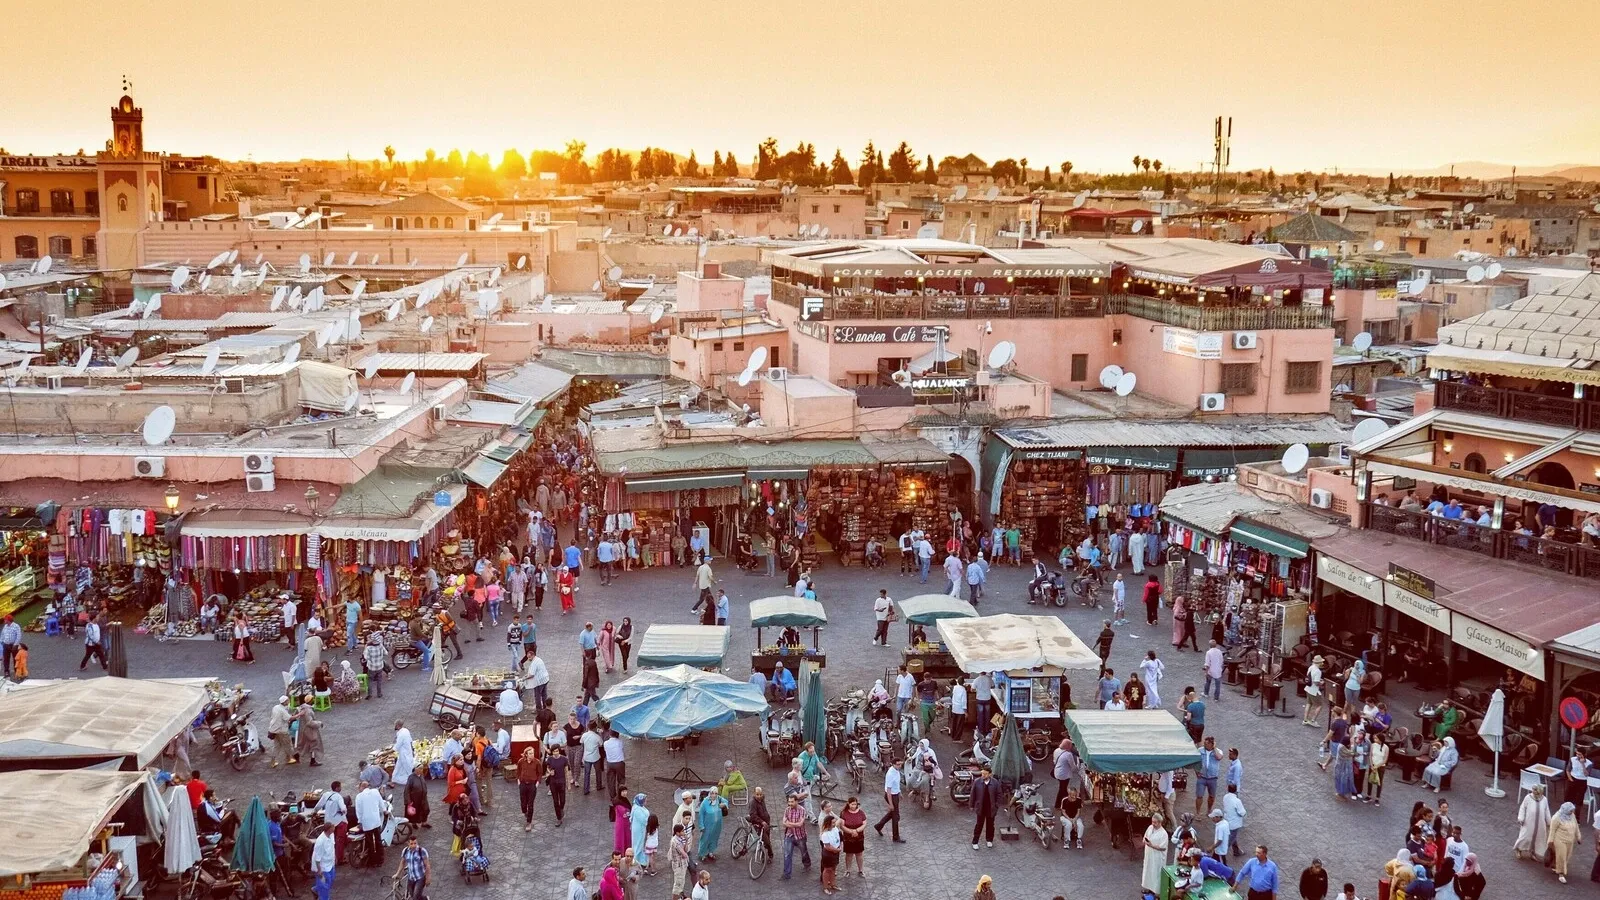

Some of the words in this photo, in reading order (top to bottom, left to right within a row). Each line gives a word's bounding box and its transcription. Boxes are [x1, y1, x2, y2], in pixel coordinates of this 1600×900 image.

[1, 157, 49, 167] ARGANA
[841, 326, 886, 343] L'ancien
[893, 326, 916, 342] Café
[1326, 563, 1346, 579] Salon
[1347, 571, 1356, 583] de
[1394, 590, 1439, 618] Restaurant
[1466, 626, 1492, 645] Glaces
[1495, 638, 1528, 661] Maison
